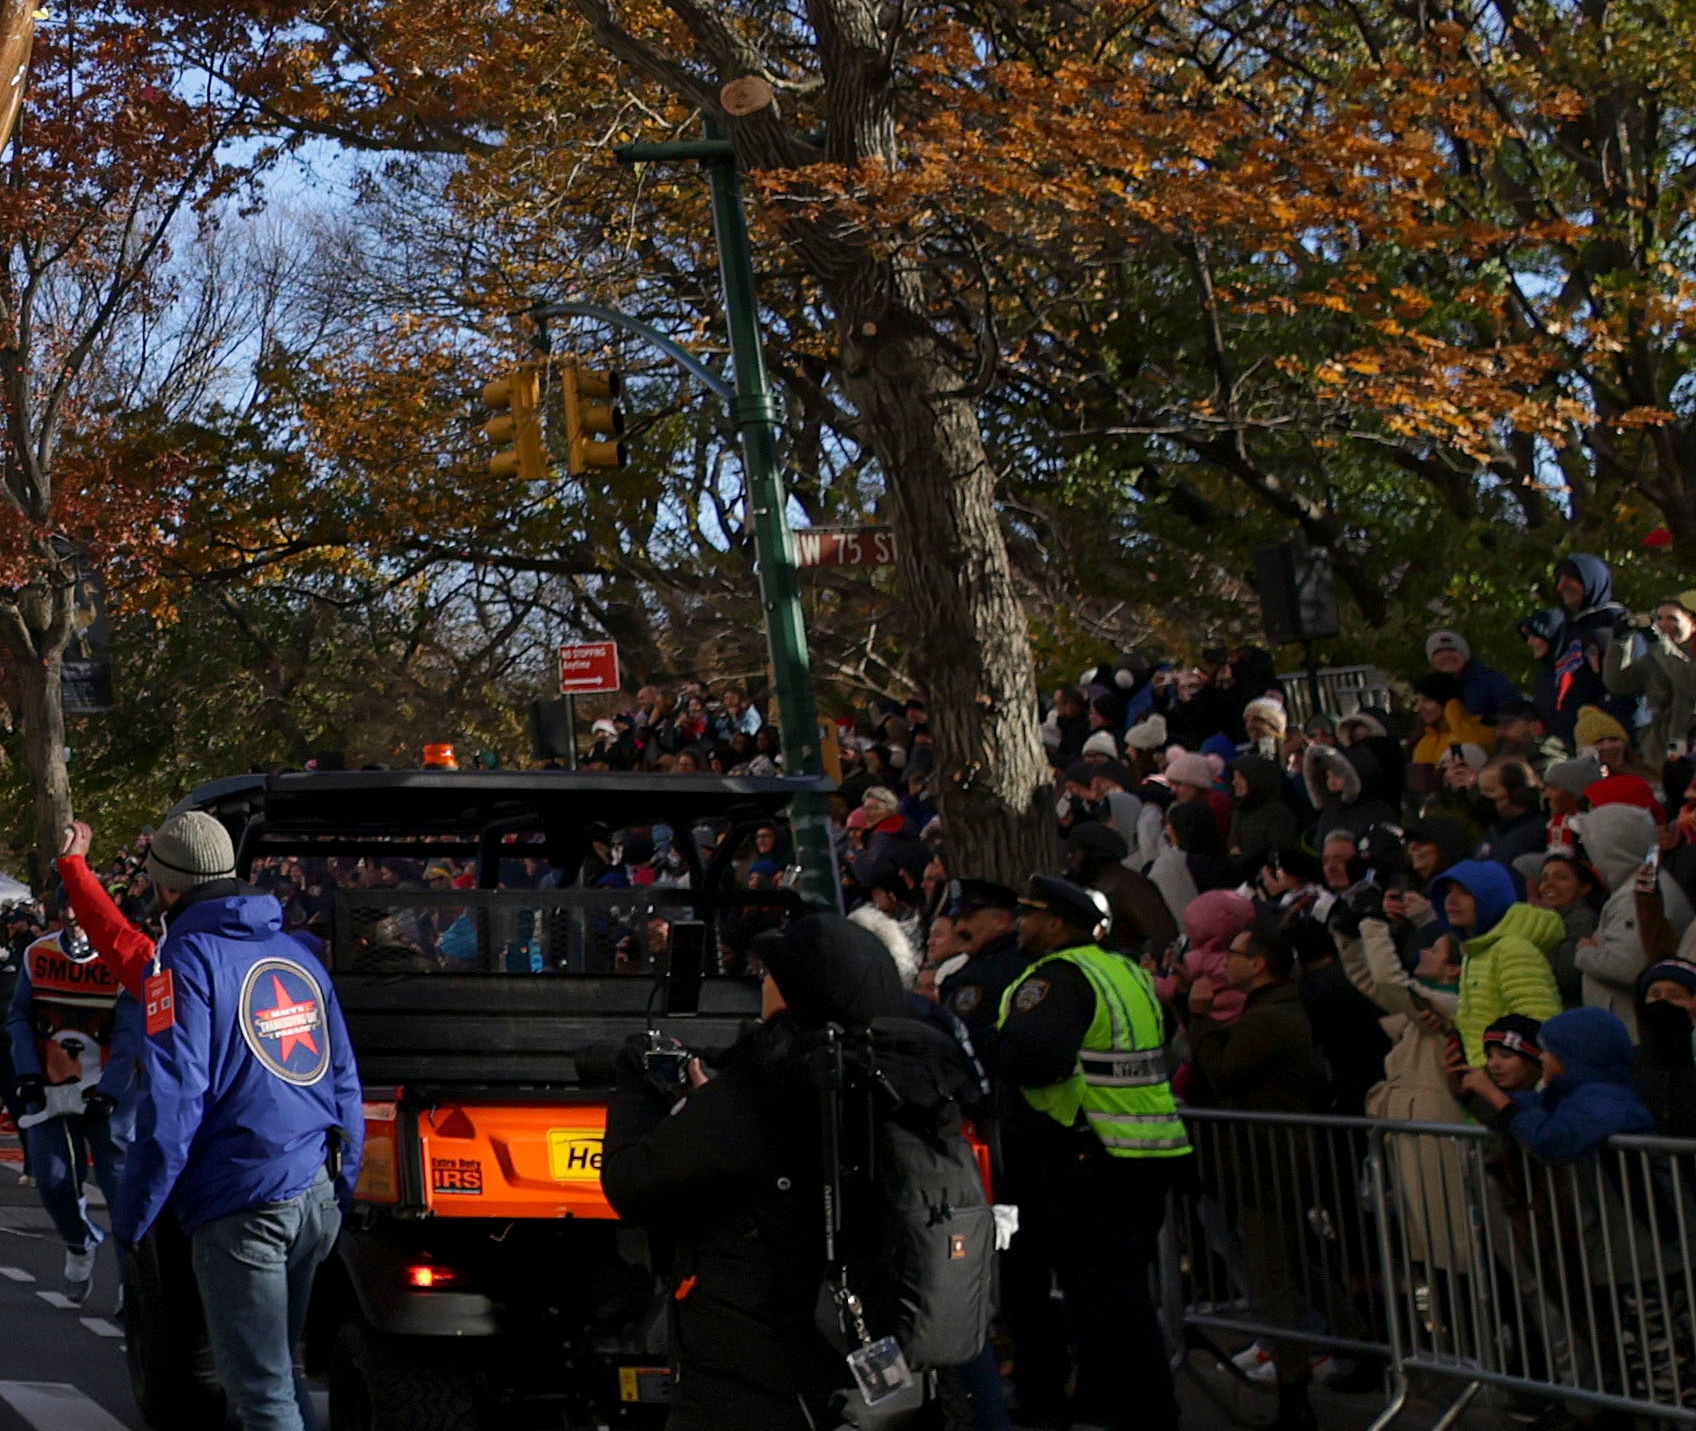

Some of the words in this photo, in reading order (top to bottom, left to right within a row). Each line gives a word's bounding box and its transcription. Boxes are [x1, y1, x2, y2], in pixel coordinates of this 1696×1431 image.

[801, 533, 820, 566] W
[832, 532, 862, 565] 75
[434, 1170, 481, 1189] IRS
